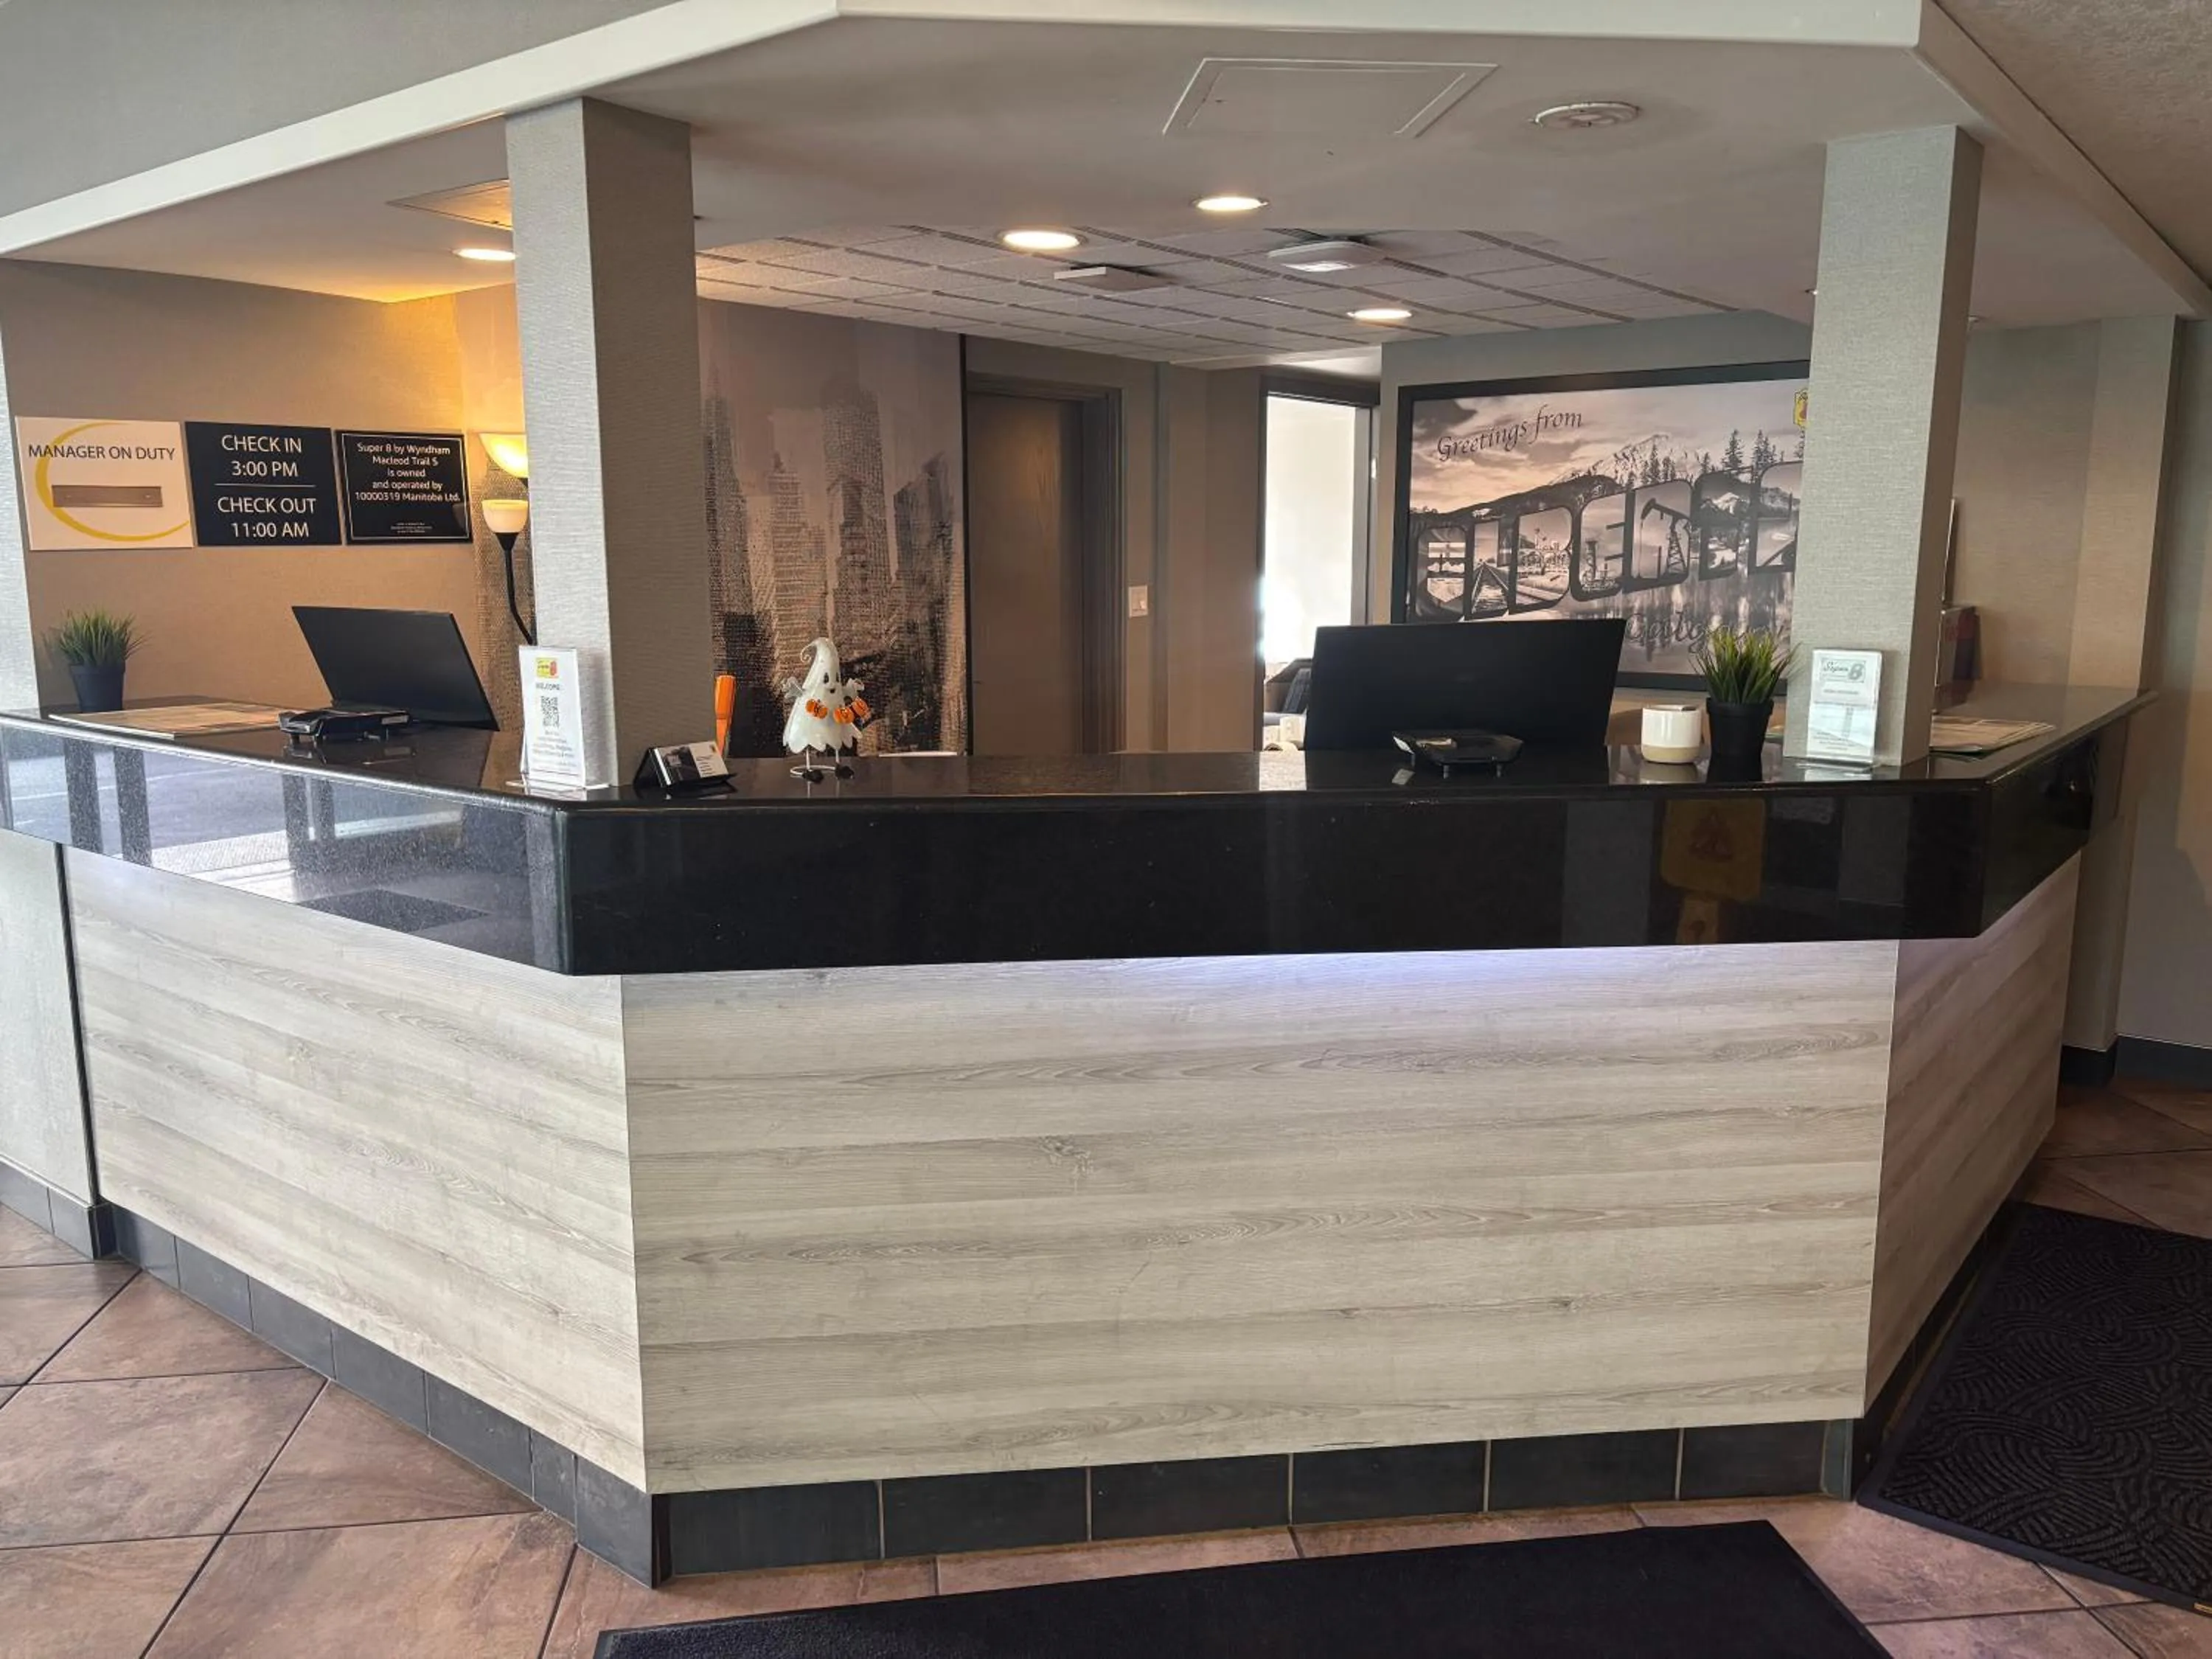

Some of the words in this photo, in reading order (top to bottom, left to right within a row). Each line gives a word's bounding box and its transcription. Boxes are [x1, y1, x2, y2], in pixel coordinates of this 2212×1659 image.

[1438, 420, 1528, 461] Greetings
[1528, 404, 1582, 444] from
[221, 434, 281, 452] CHECK
[285, 437, 302, 453] IN
[357, 442, 383, 454] Super
[386, 443, 391, 453] 8
[393, 443, 405, 454] by
[406, 445, 451, 456] Wyndham
[29, 444, 105, 459] MANAGER
[108, 445, 132, 459] ON
[136, 447, 175, 460] DUTY
[231, 460, 268, 476] 3:00
[271, 461, 299, 477] PM
[372, 456, 409, 465] Macleod
[411, 456, 430, 466] Trail
[432, 457, 439, 467] S
[396, 468, 426, 477] owned
[372, 480, 389, 489] and
[391, 481, 430, 491] operated
[431, 481, 443, 492] by
[217, 496, 277, 513] CHECK
[280, 498, 316, 514] OUT
[355, 492, 400, 501] 10000319
[402, 493, 442, 502] Manitoba
[445, 493, 461, 502] Ltd.
[231, 522, 276, 538] 11:00
[282, 521, 310, 538] AM
